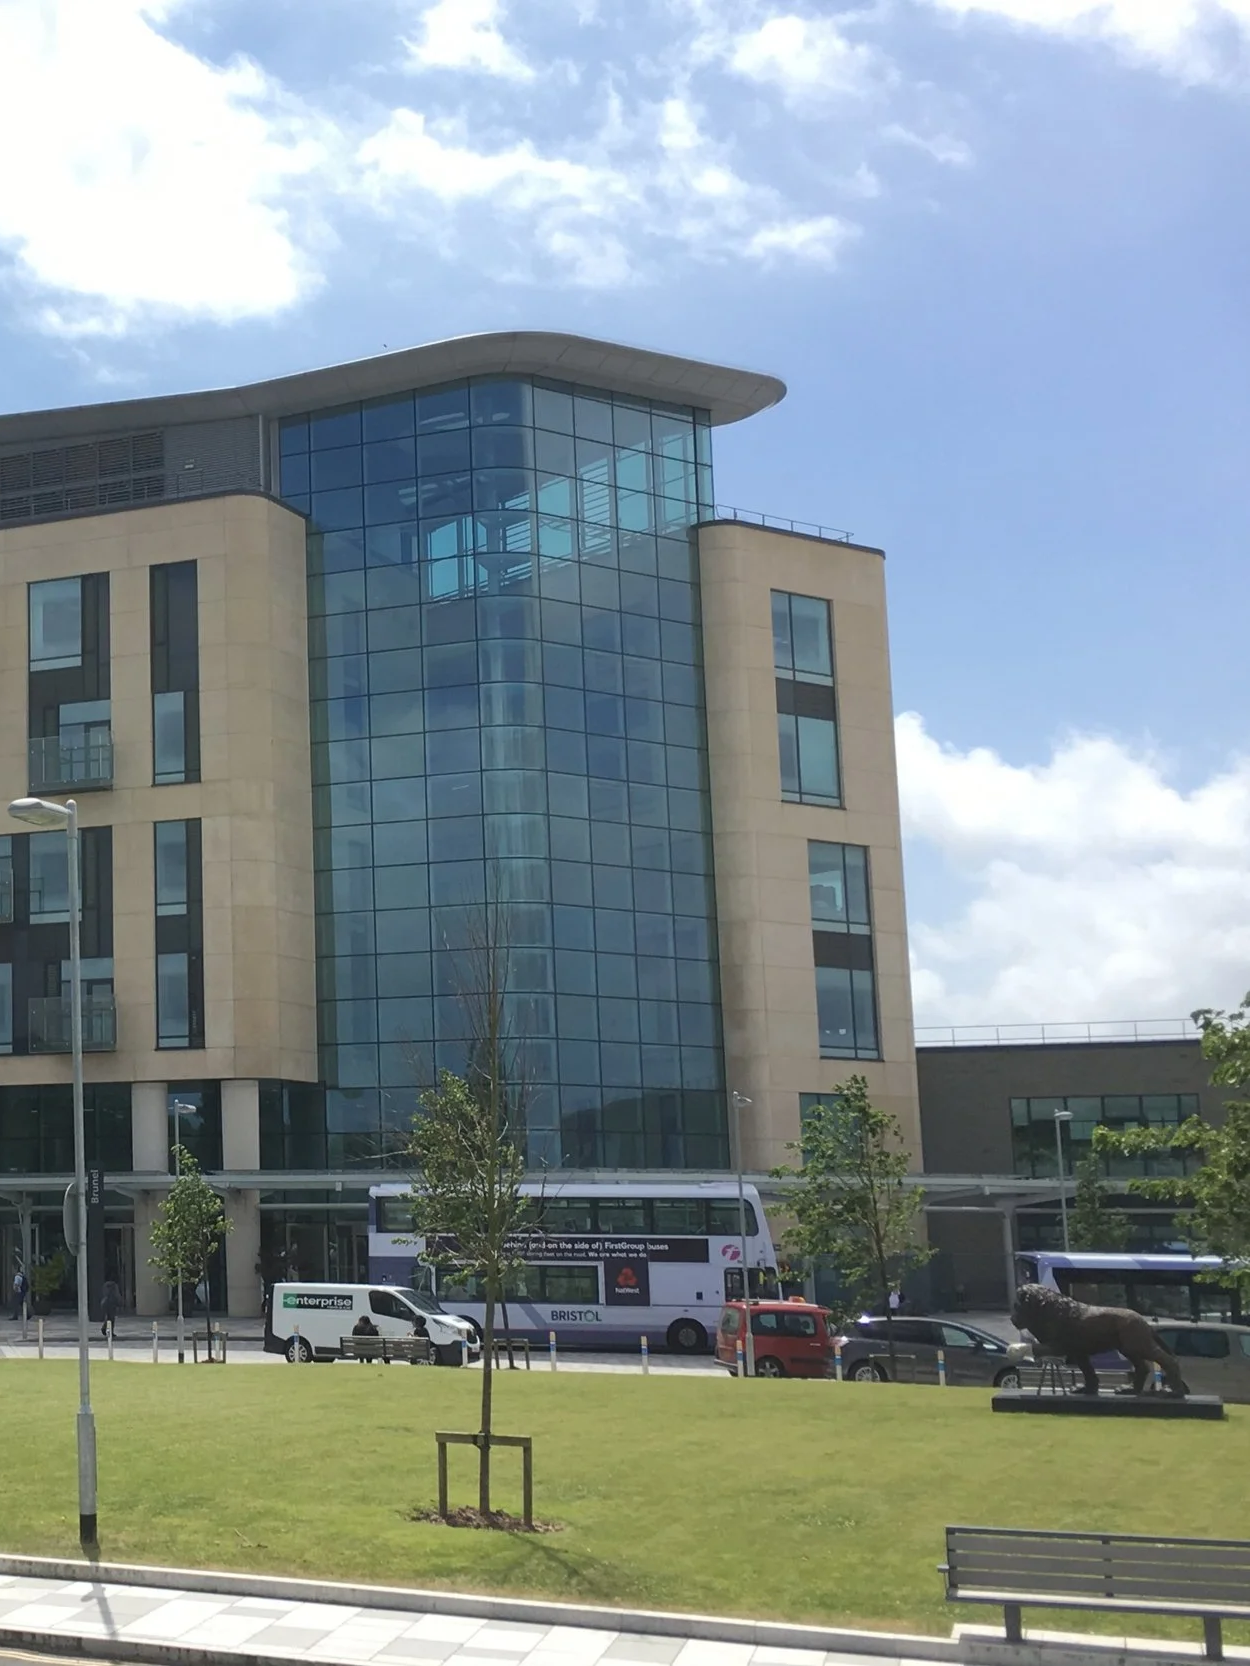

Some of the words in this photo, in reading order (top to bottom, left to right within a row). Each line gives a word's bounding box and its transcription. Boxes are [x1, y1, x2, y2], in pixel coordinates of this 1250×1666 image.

[90, 1169, 99, 1203] Brunel
[559, 1241, 572, 1249] the
[574, 1241, 589, 1249] side
[591, 1241, 603, 1250] of)
[604, 1241, 645, 1251] FirstGroup
[646, 1242, 669, 1250] buses
[285, 1296, 352, 1308] enterprise
[551, 1310, 603, 1322] BRISTOL
